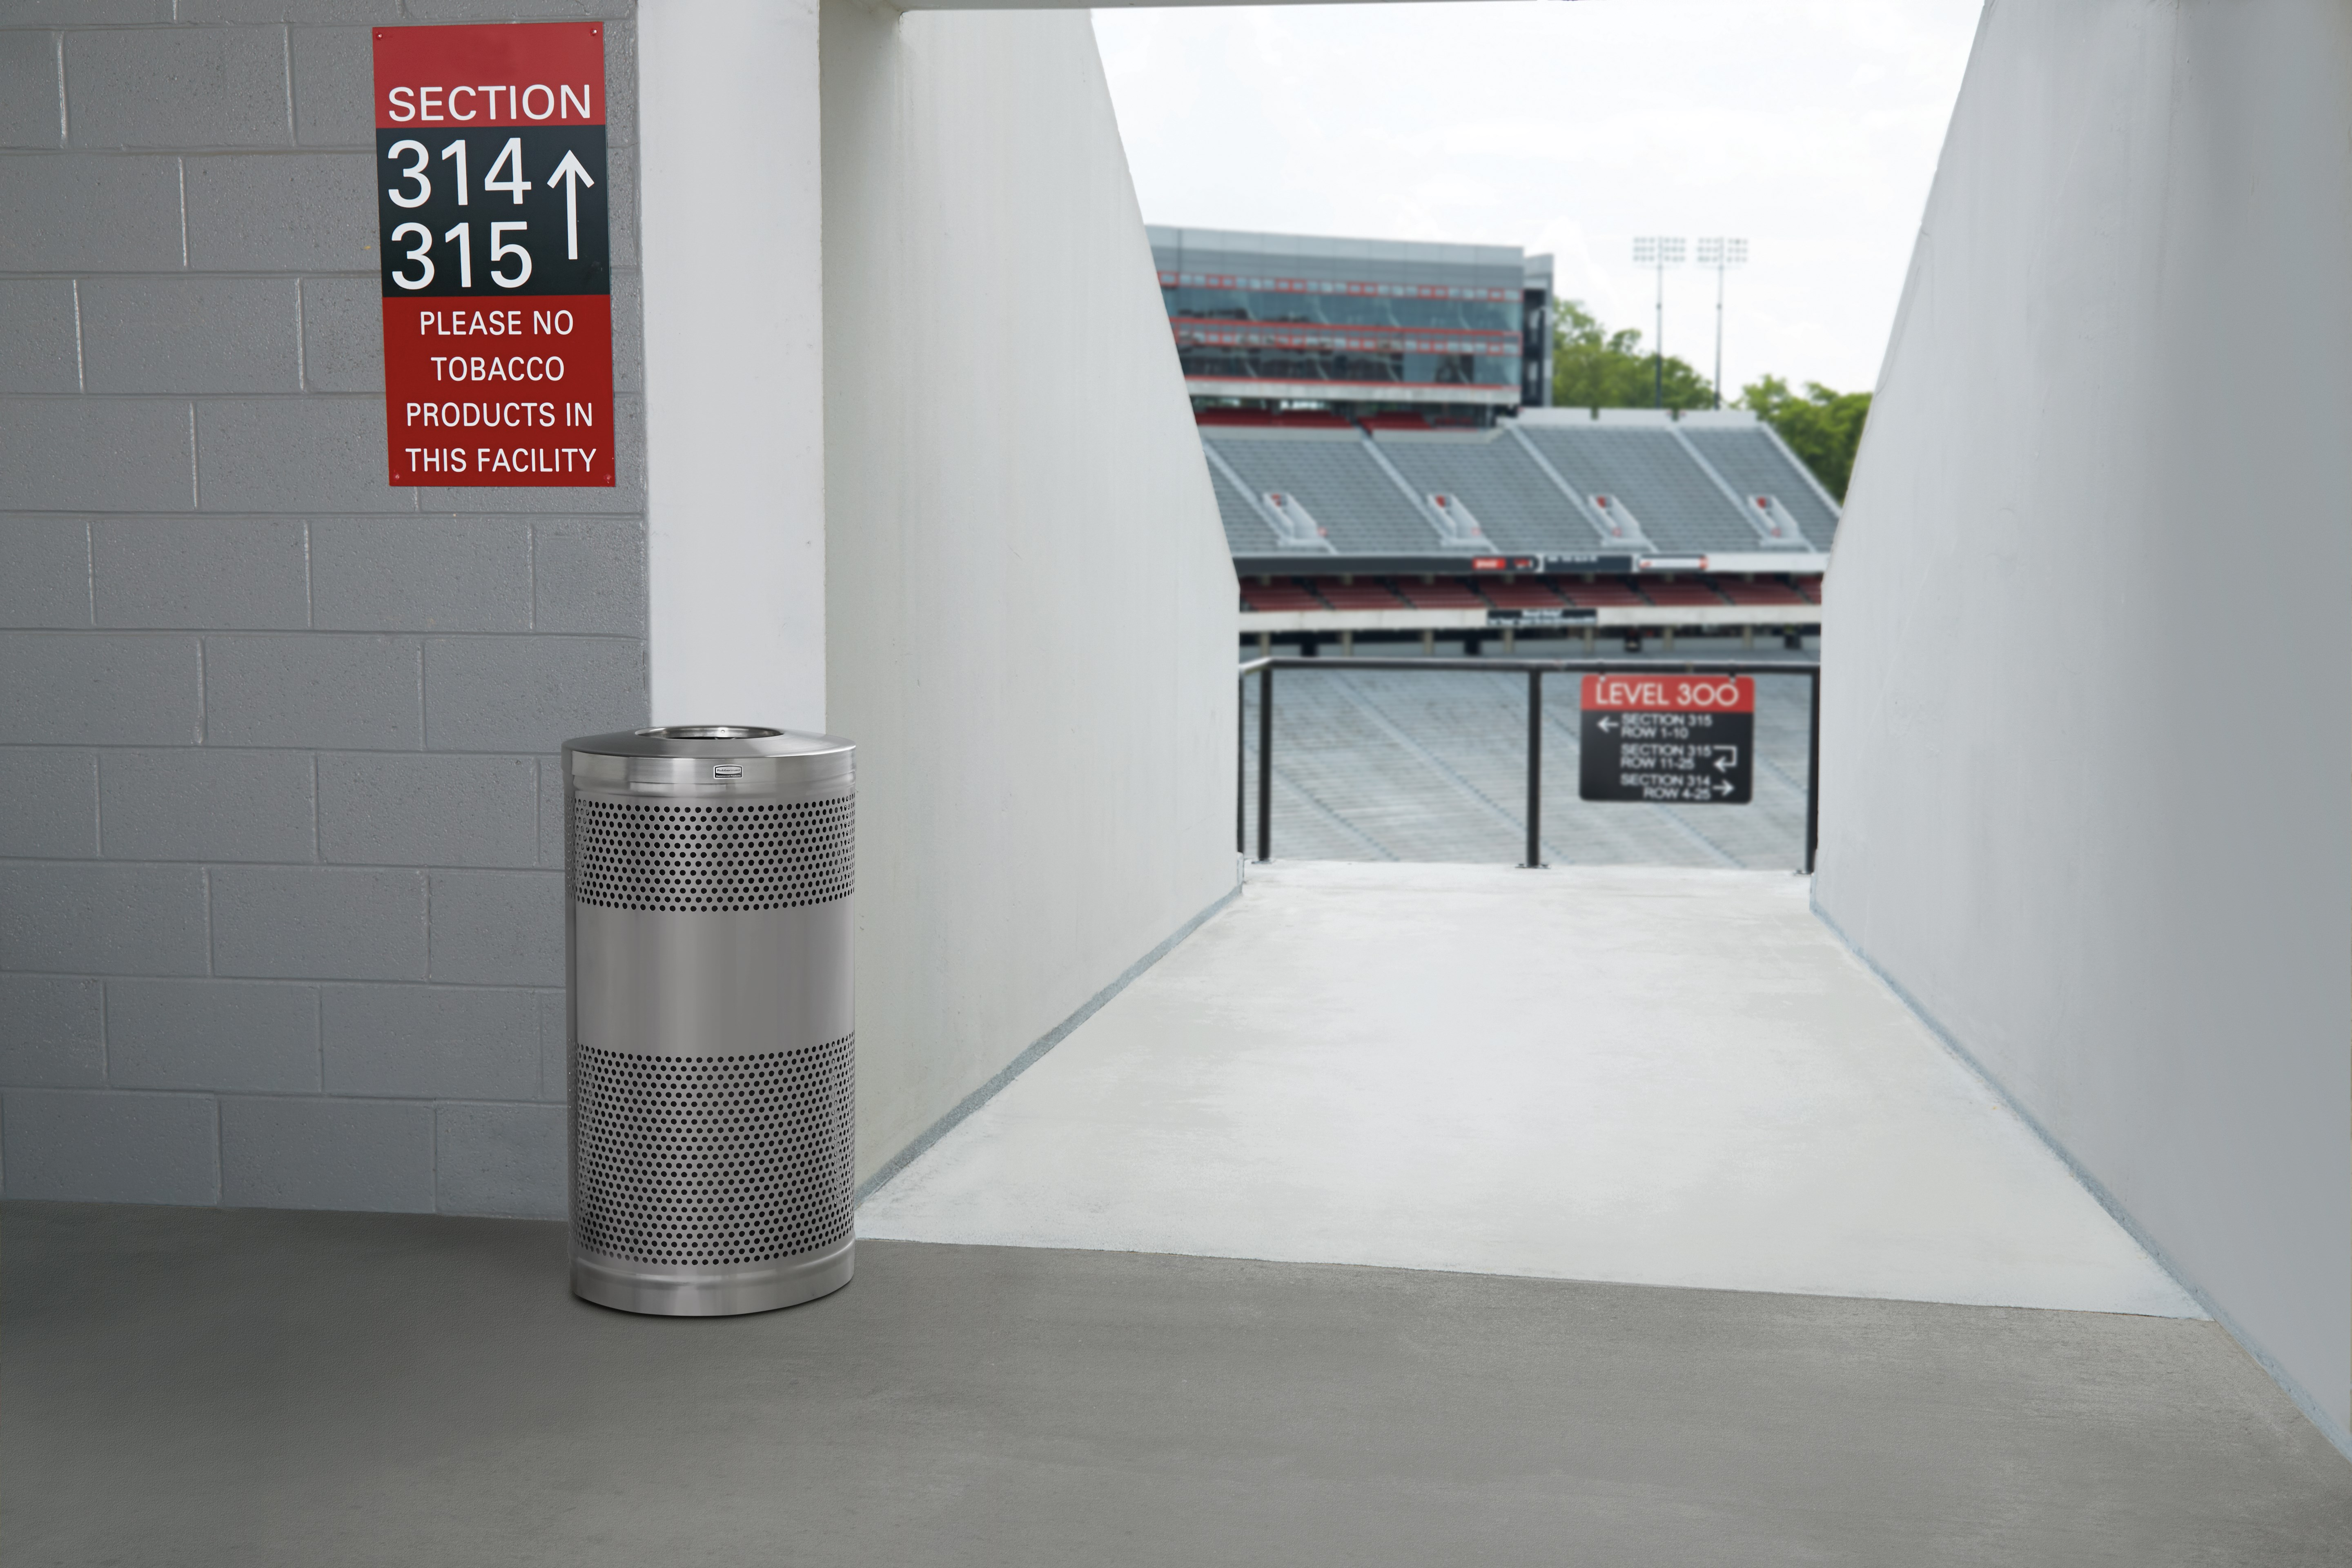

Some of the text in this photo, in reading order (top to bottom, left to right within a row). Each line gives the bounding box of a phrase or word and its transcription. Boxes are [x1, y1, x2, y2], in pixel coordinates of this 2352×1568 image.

[389, 84, 590, 122] SECTION
[388, 137, 532, 208] 314
[391, 221, 532, 290] 315
[420, 310, 573, 336] PLEASE NO
[430, 356, 564, 381] TOBACCO
[407, 402, 592, 427] PRODUCTS IN
[405, 448, 597, 472] THIS FACILITY
[1596, 683, 1739, 706] LEVEL 300
[1621, 713, 1713, 727] SECTION 315
[1621, 727, 1689, 739] ROW 1-10
[1621, 744, 1712, 757] SECTION 315
[1621, 757, 1656, 768] ROW
[1621, 774, 1710, 787] SECTION 314
[1643, 787, 1679, 799] ROW
